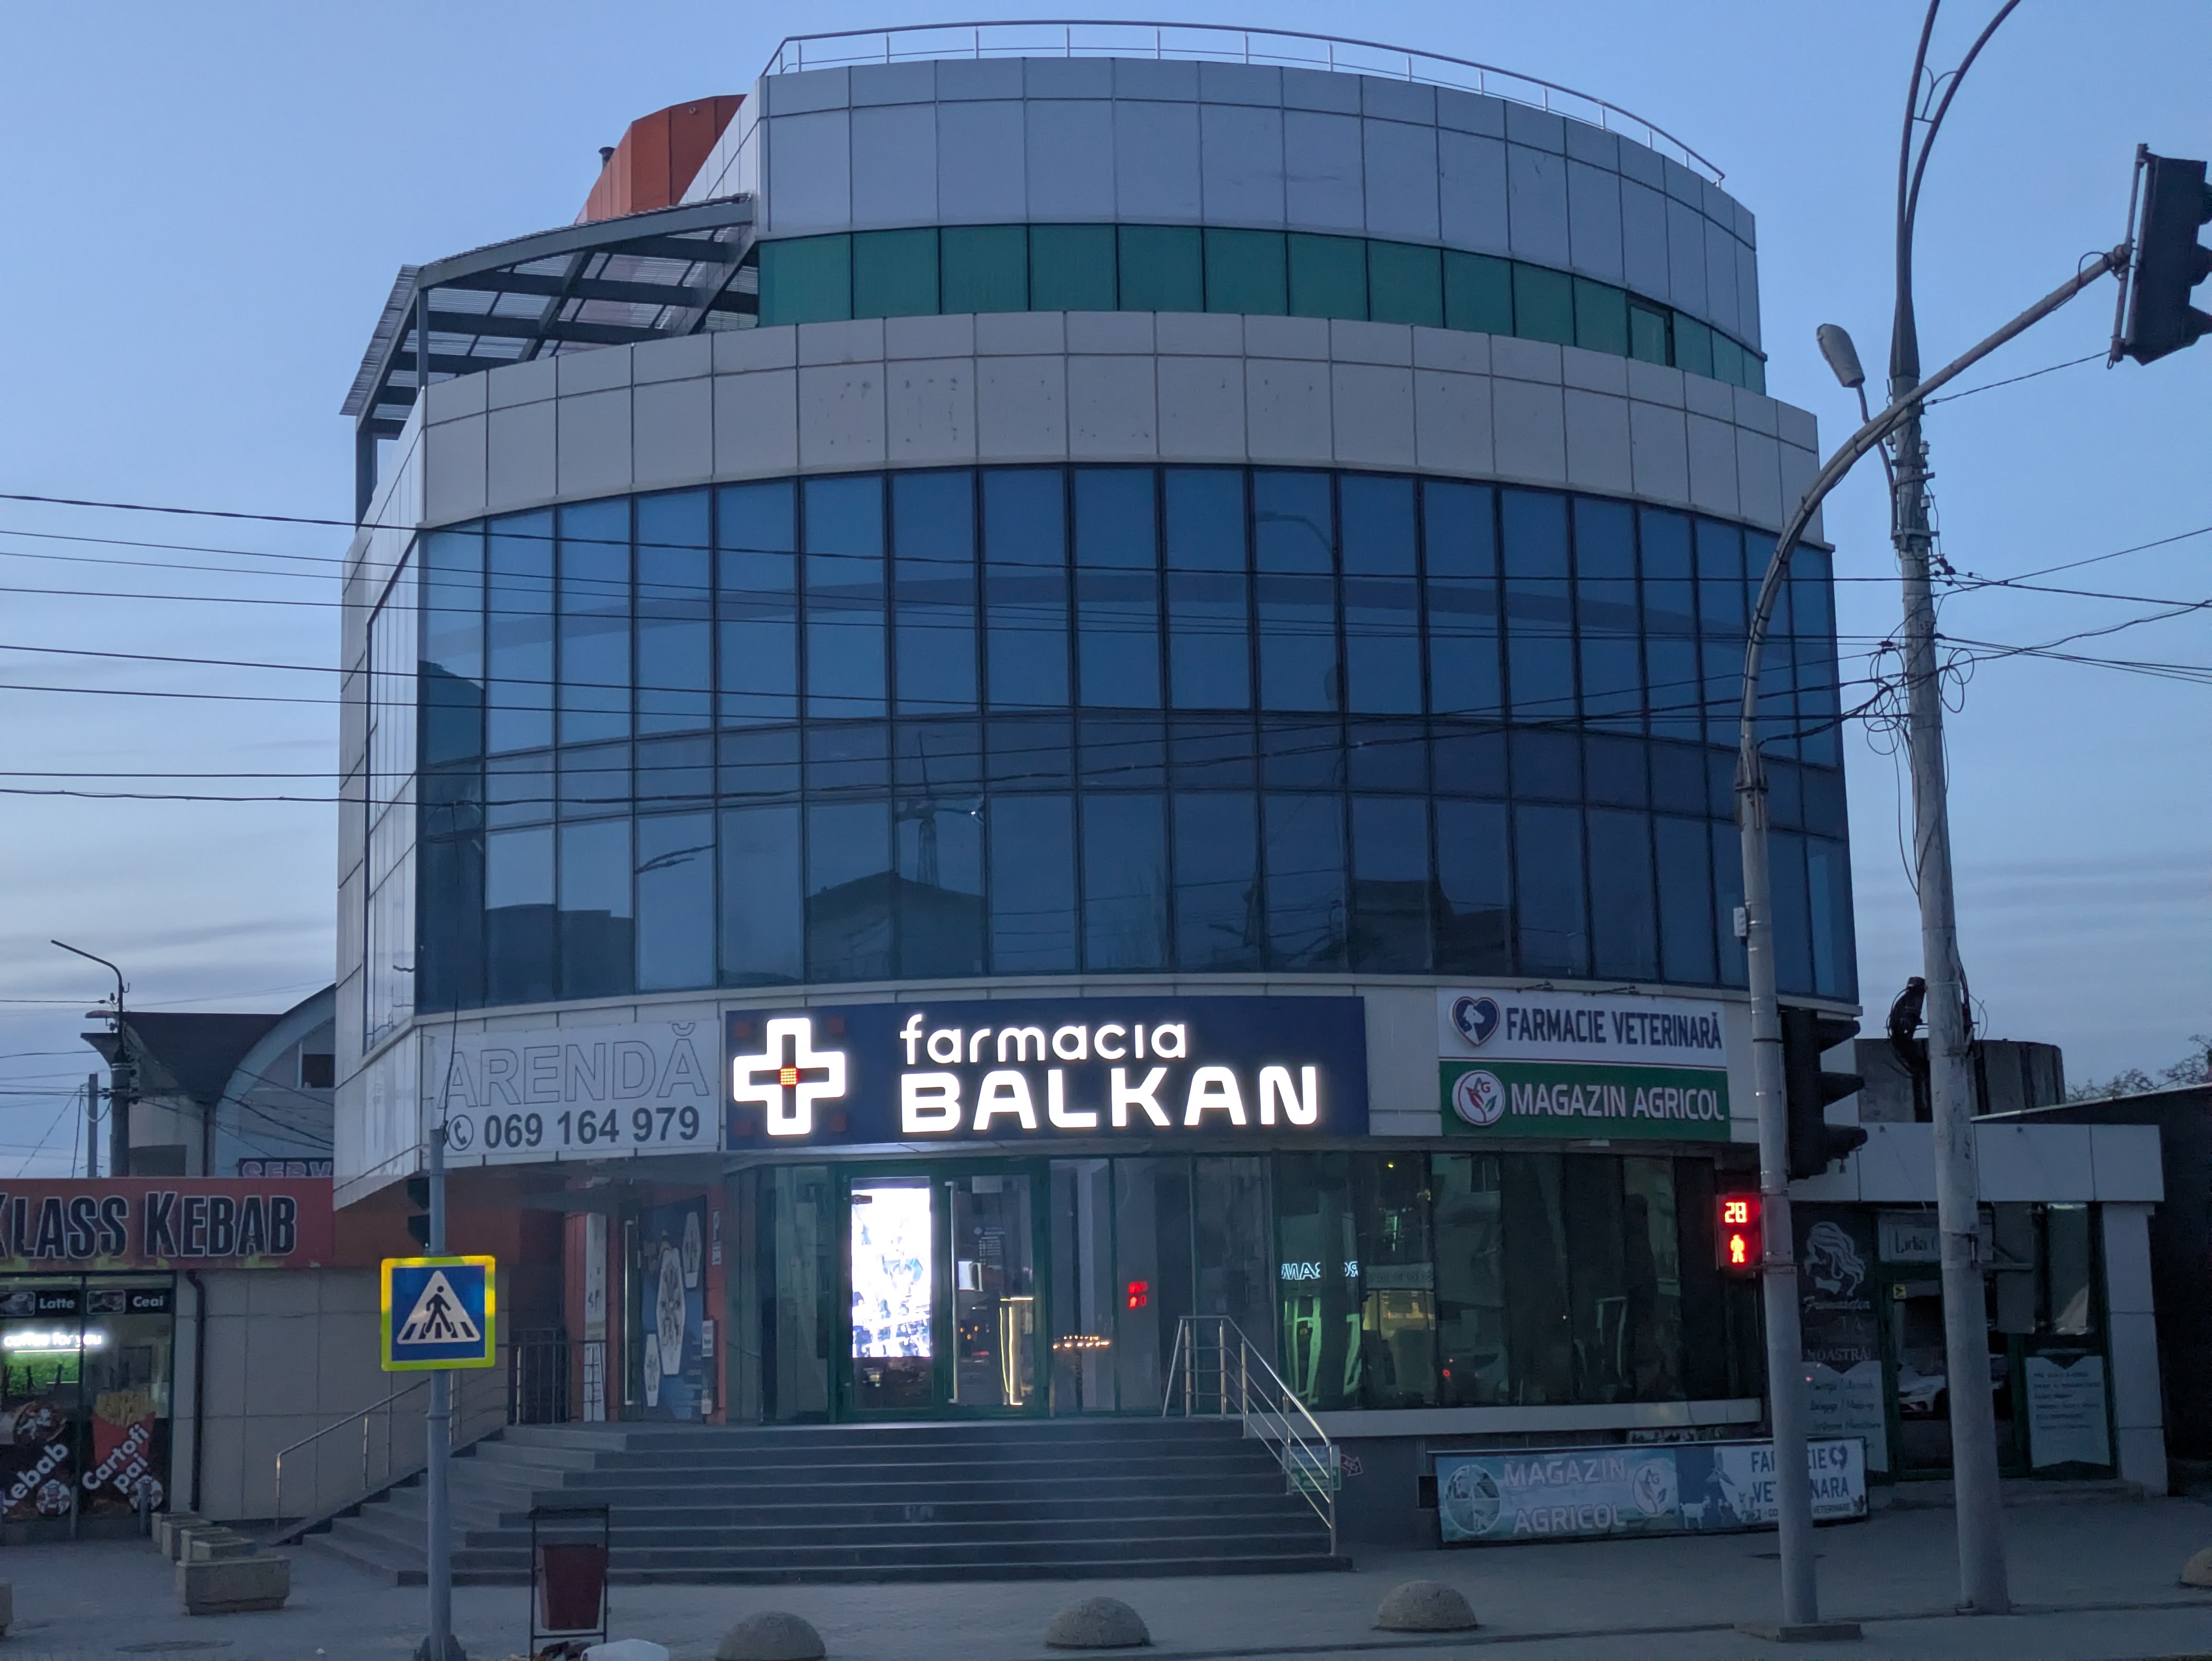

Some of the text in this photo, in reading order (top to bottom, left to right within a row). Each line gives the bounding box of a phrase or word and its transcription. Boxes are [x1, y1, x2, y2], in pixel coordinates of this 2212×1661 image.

[1506, 1007, 1723, 1050] FARMACIE VETERINARĂ
[437, 1022, 709, 1109] ARENDĂ
[901, 1066, 1317, 1133] BALKAN
[1511, 1083, 1725, 1121] MAGAZIN AGRICOL
[484, 1106, 699, 1149] 069 164 979
[144, 1191, 297, 1257] KEBAB
[1725, 1201, 1747, 1223] 28
[39, 1297, 75, 1309] Latte
[133, 1295, 164, 1307] Ceai
[82, 1424, 149, 1490] Cartofi
[113, 1452, 148, 1495] pai
[1503, 1457, 1627, 1487] MAGAZIN
[1751, 1448, 1827, 1473] FAIE
[1752, 1477, 1849, 1503] VENARA
[1513, 1503, 1627, 1534] AGRICOL
